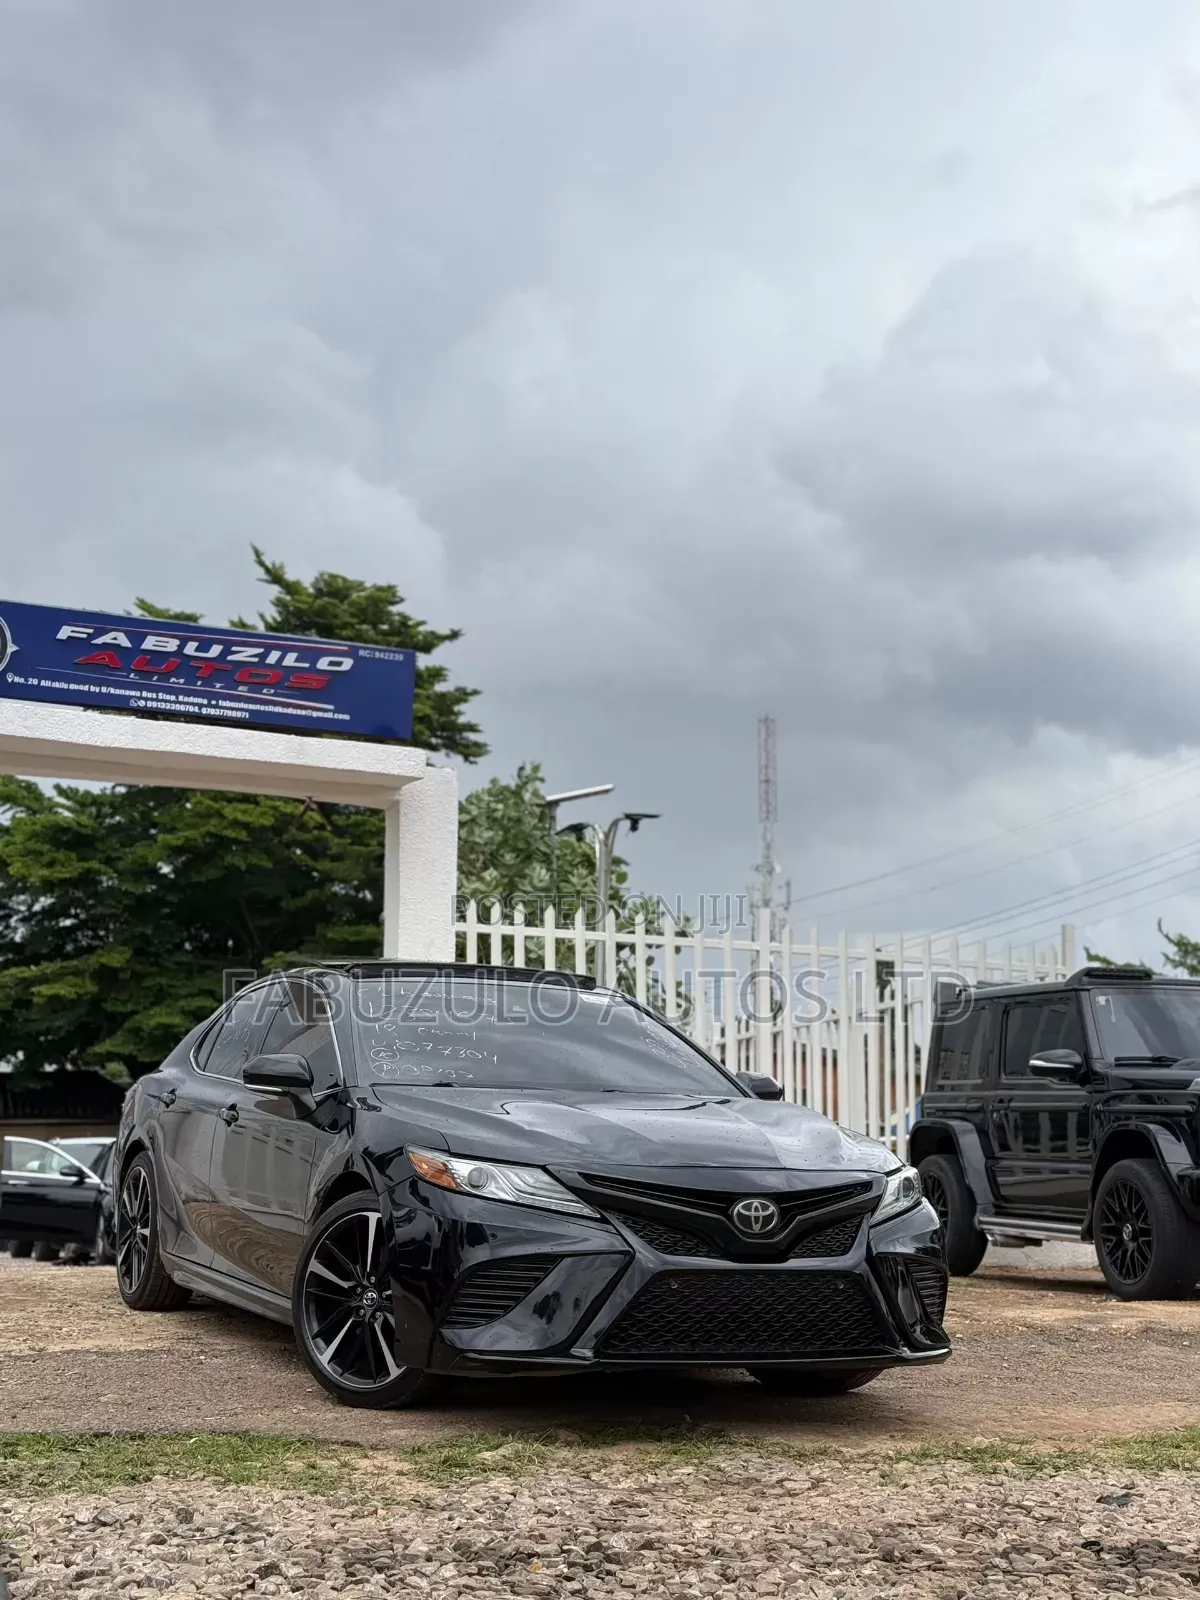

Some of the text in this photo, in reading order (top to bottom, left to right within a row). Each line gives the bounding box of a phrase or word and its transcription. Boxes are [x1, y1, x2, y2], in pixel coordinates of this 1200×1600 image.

[56, 625, 353, 671] FABUZILO
[73, 651, 330, 690] AUTOS
[129, 673, 275, 694] LIMITED
[13, 675, 27, 684] No.
[27, 677, 38, 686] 20
[90, 685, 100, 694] by
[142, 691, 157, 699] Bus
[179, 695, 208, 704] Kaduna
